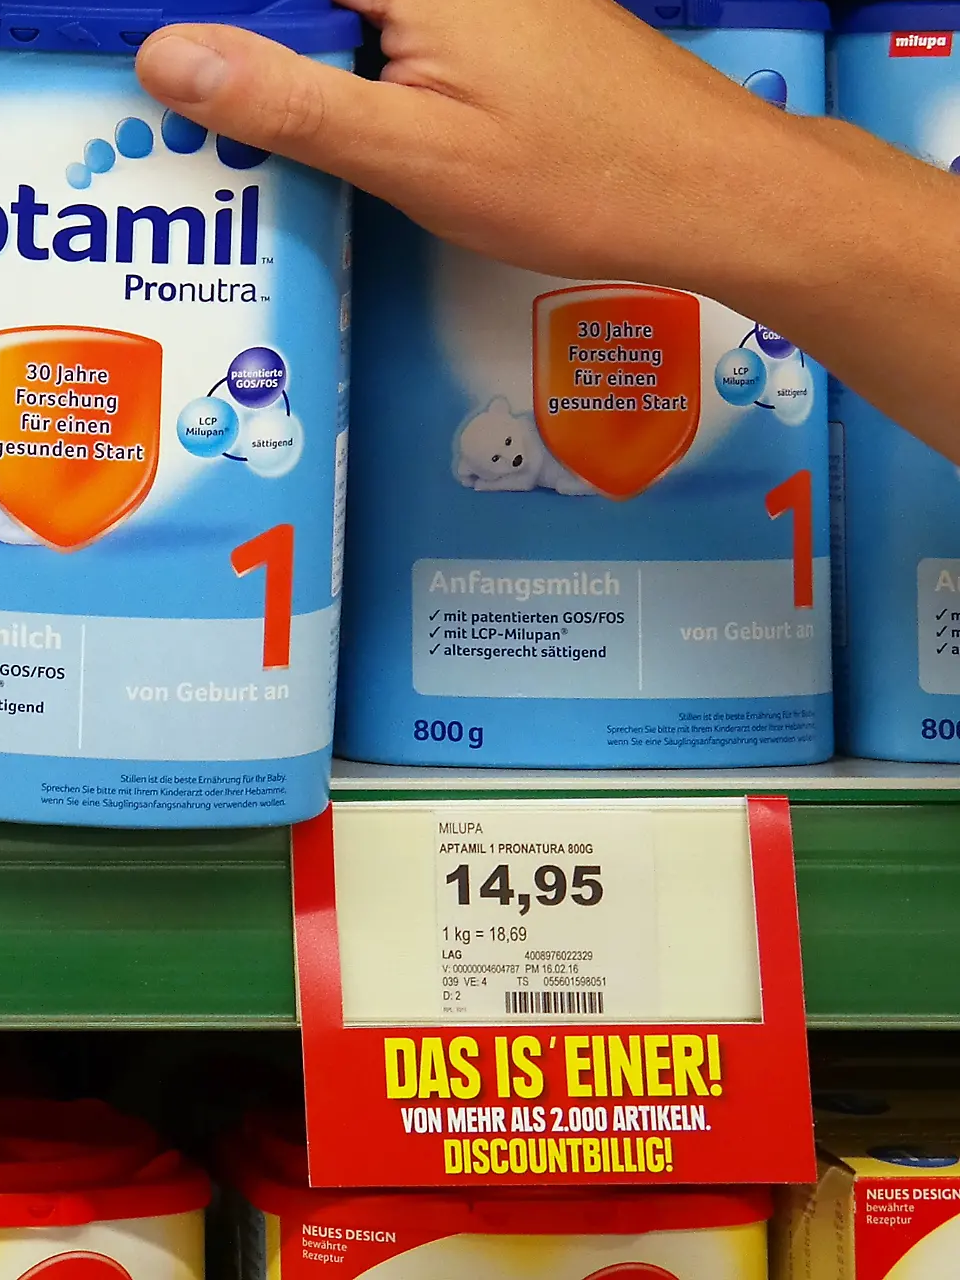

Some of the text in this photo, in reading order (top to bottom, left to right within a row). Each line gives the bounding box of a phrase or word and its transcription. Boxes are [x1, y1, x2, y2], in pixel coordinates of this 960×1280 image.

[895, 34, 946, 49] milupa
[26, 364, 108, 385] 30 Jahre
[231, 368, 283, 380] patentierte
[236, 378, 277, 390] GOS/FOS
[16, 389, 118, 413] Forschung
[21, 413, 110, 434] für einen
[199, 417, 217, 426] LCP
[95, 441, 144, 461] Start
[252, 437, 293, 450] sättigend
[229, 523, 294, 671] 1
[0, 664, 65, 679] GOS/FOS
[125, 681, 288, 702] von Geburt an
[439, 822, 483, 834] MILUPA
[439, 843, 594, 855] APTAMIL 1 PRONATURA 800G
[445, 864, 603, 917] 14,95
[442, 950, 593, 961] LAG 4008976022329
[383, 1036, 481, 1100] DAS
[567, 1034, 723, 1097] EINER!
[402, 1105, 711, 1134] VON MEHR ALS 2.000 ARTIKELN.
[444, 1137, 674, 1174] DISCOUNTBILLIG!
